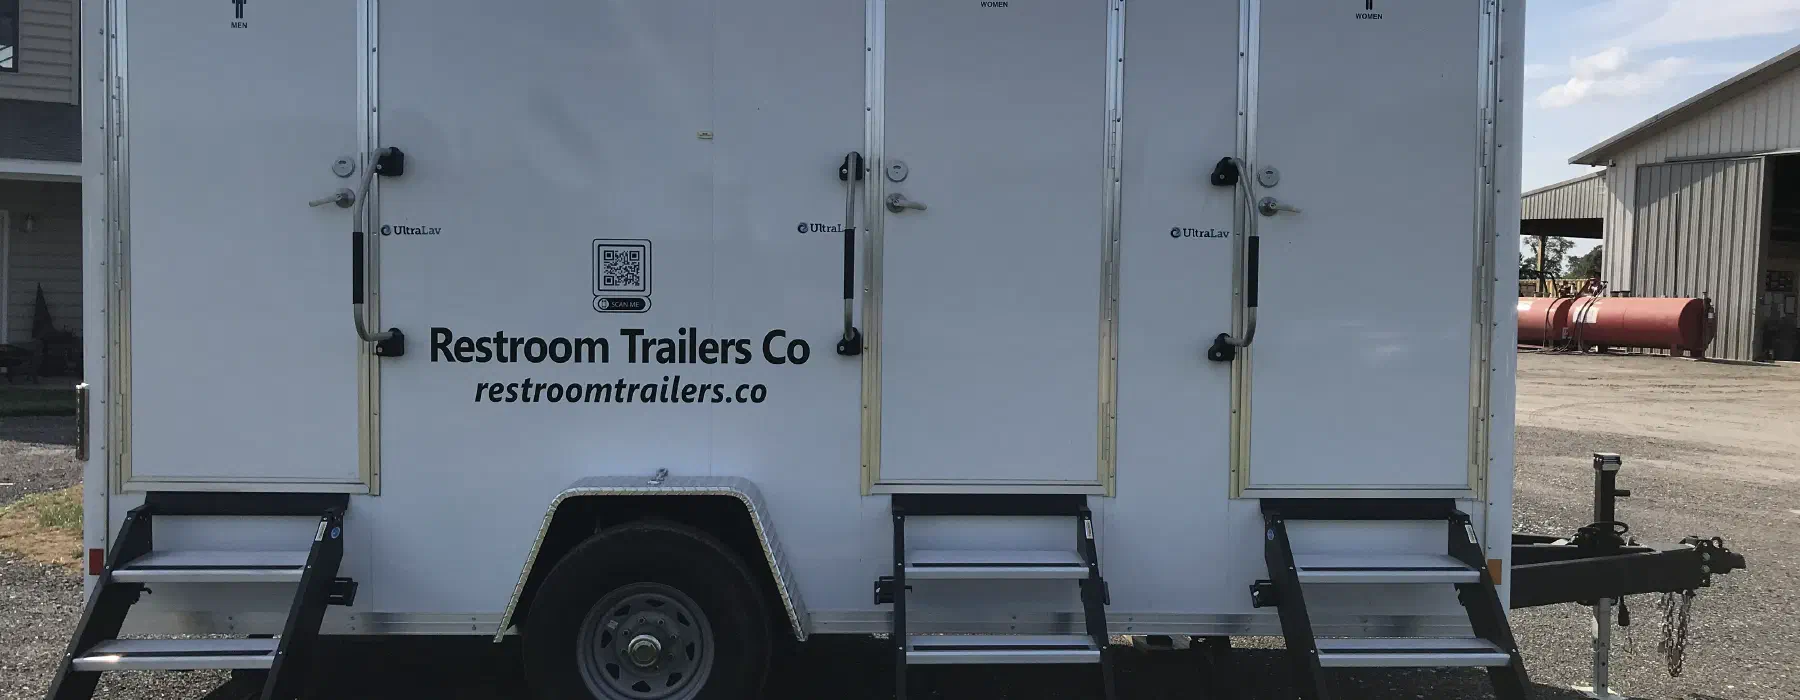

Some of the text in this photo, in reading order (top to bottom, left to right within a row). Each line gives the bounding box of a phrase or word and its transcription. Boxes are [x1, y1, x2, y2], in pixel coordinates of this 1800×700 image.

[230, 21, 248, 29] MEN
[393, 225, 442, 236] UltraLav
[810, 223, 856, 233] UltraL
[1182, 227, 1230, 238] UltraLav
[430, 327, 811, 365] Restroom Trailers Co
[474, 375, 768, 404] restroomtrailers.co
